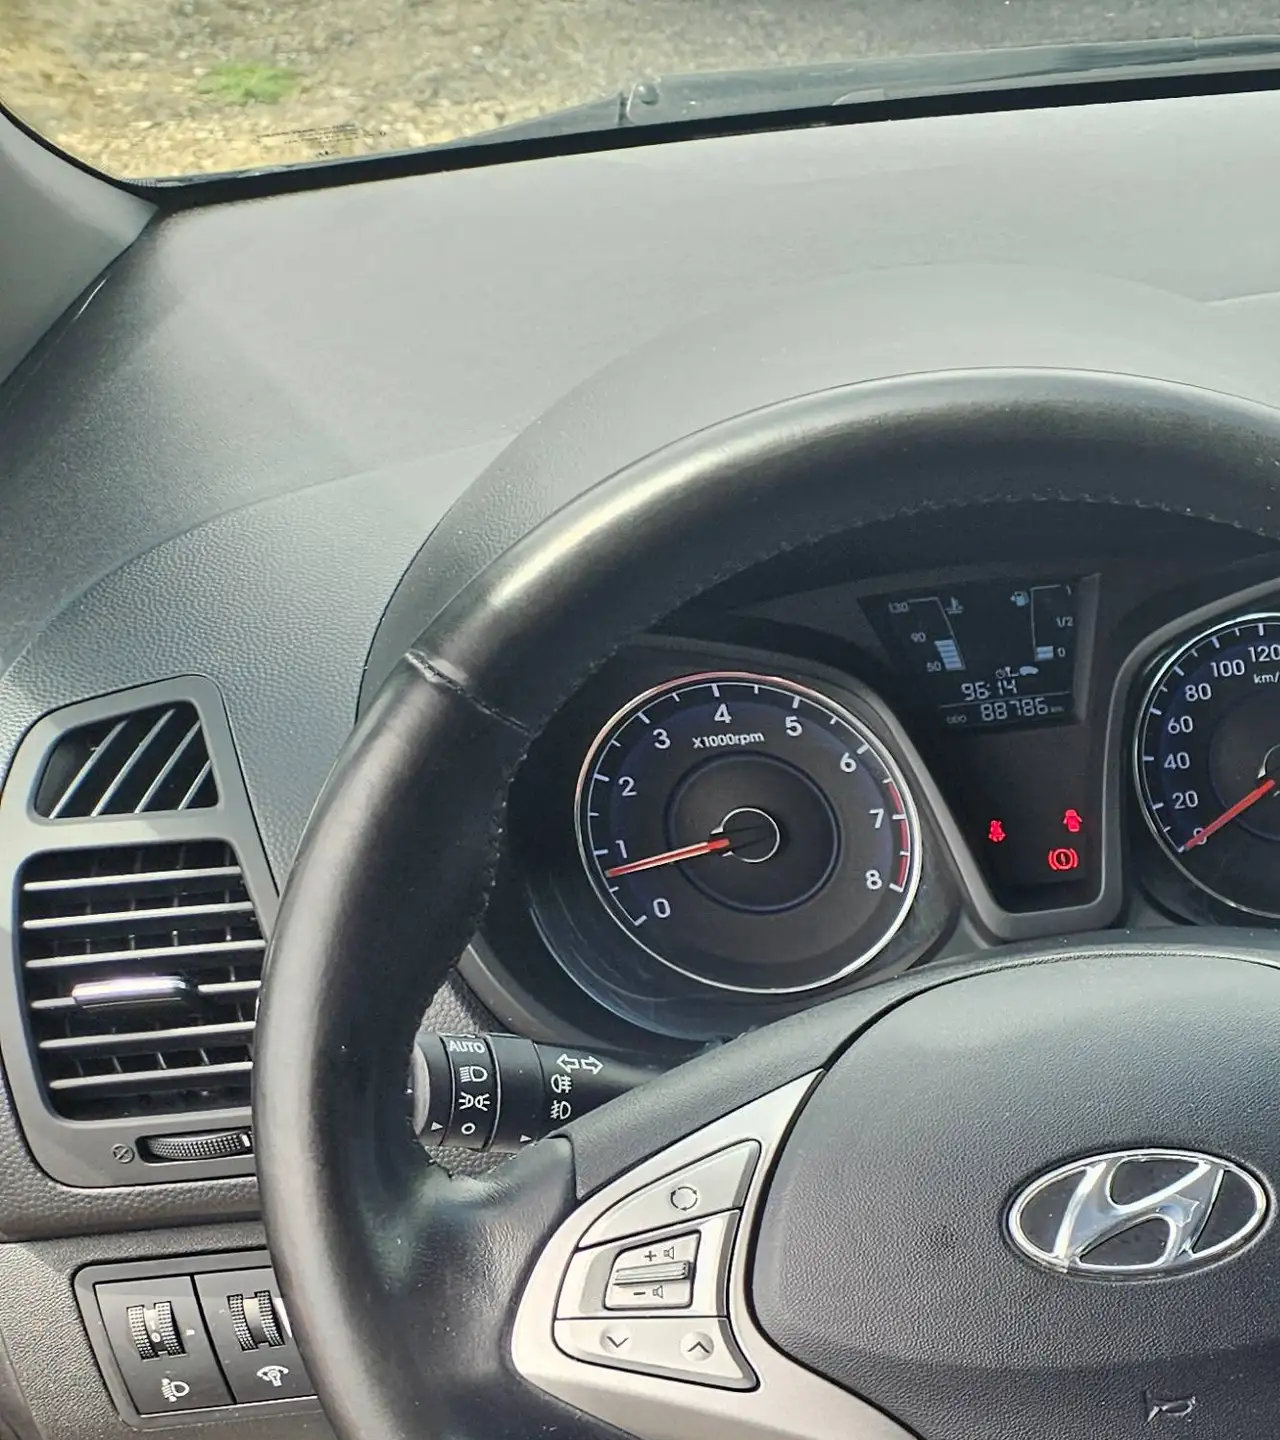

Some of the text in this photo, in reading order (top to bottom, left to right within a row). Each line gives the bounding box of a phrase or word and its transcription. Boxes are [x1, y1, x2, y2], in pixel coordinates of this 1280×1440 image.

[910, 631, 926, 643] 90
[927, 661, 942, 672] 50
[1210, 659, 1245, 678] 100
[1185, 682, 1212, 702] 80
[714, 703, 732, 723] 4
[785, 716, 803, 737] 5
[1168, 716, 1194, 734] 60
[653, 728, 671, 749] 3
[839, 754, 858, 773] 6
[1163, 752, 1190, 770] 40
[618, 777, 637, 797] 2
[1172, 790, 1198, 809] 20
[869, 808, 885, 828] 7
[616, 840, 628, 858] 1
[865, 870, 882, 889] 8
[653, 898, 671, 919] 0
[449, 1040, 485, 1054] AUTO
